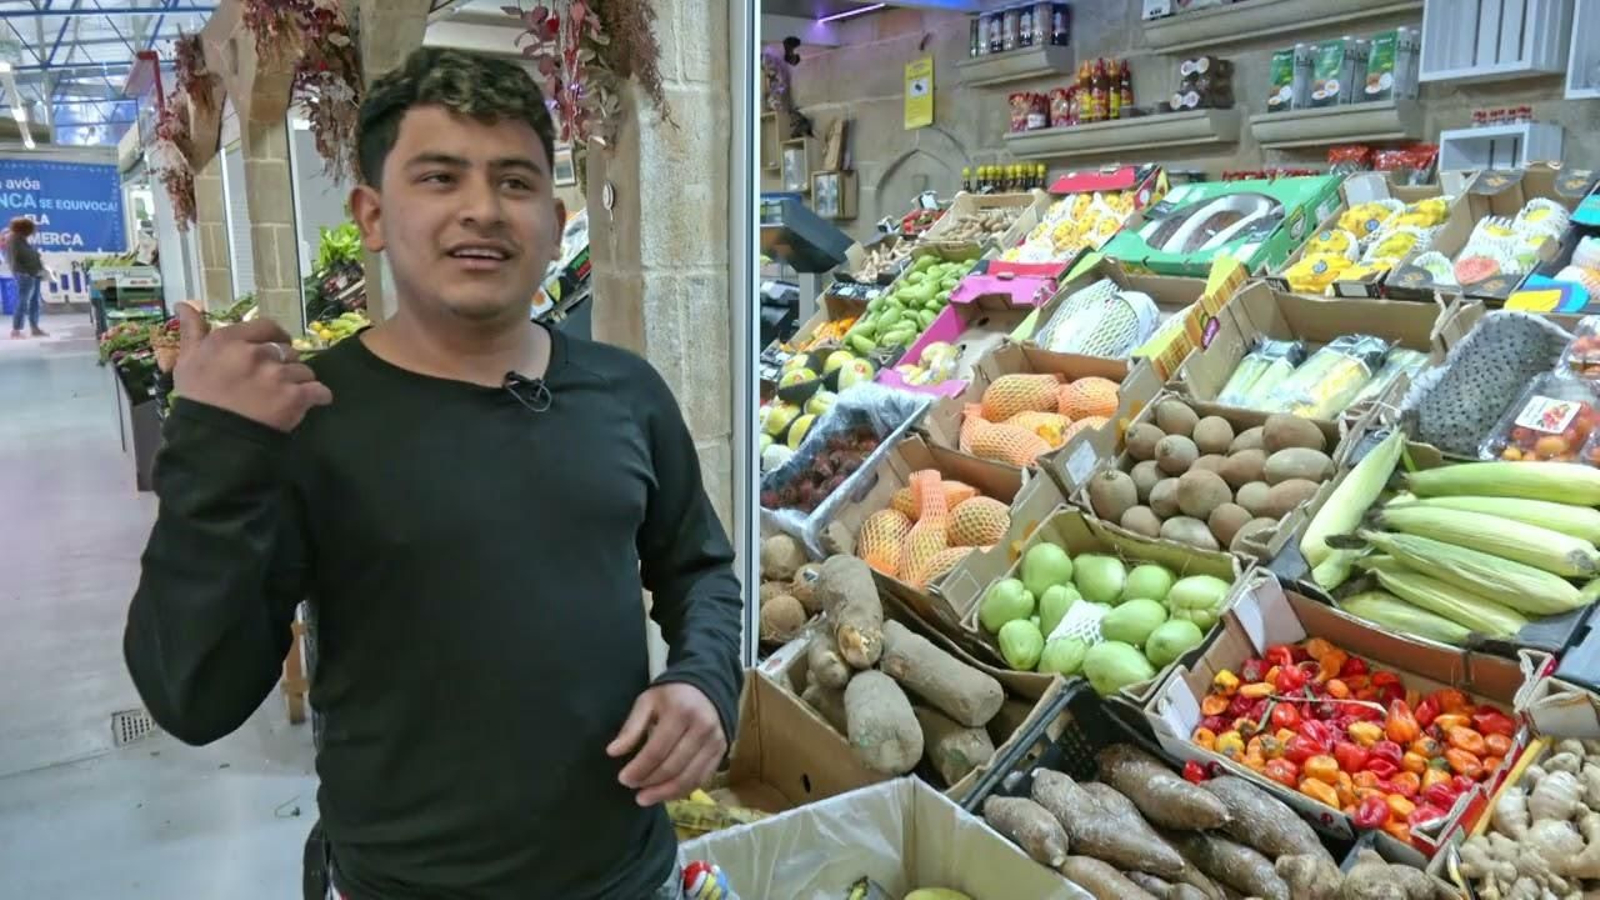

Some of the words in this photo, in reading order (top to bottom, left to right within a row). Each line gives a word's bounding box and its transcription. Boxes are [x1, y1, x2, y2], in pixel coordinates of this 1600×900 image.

[6, 177, 40, 190] avóa
[39, 199, 53, 209] SE
[27, 232, 84, 246] MERCA
